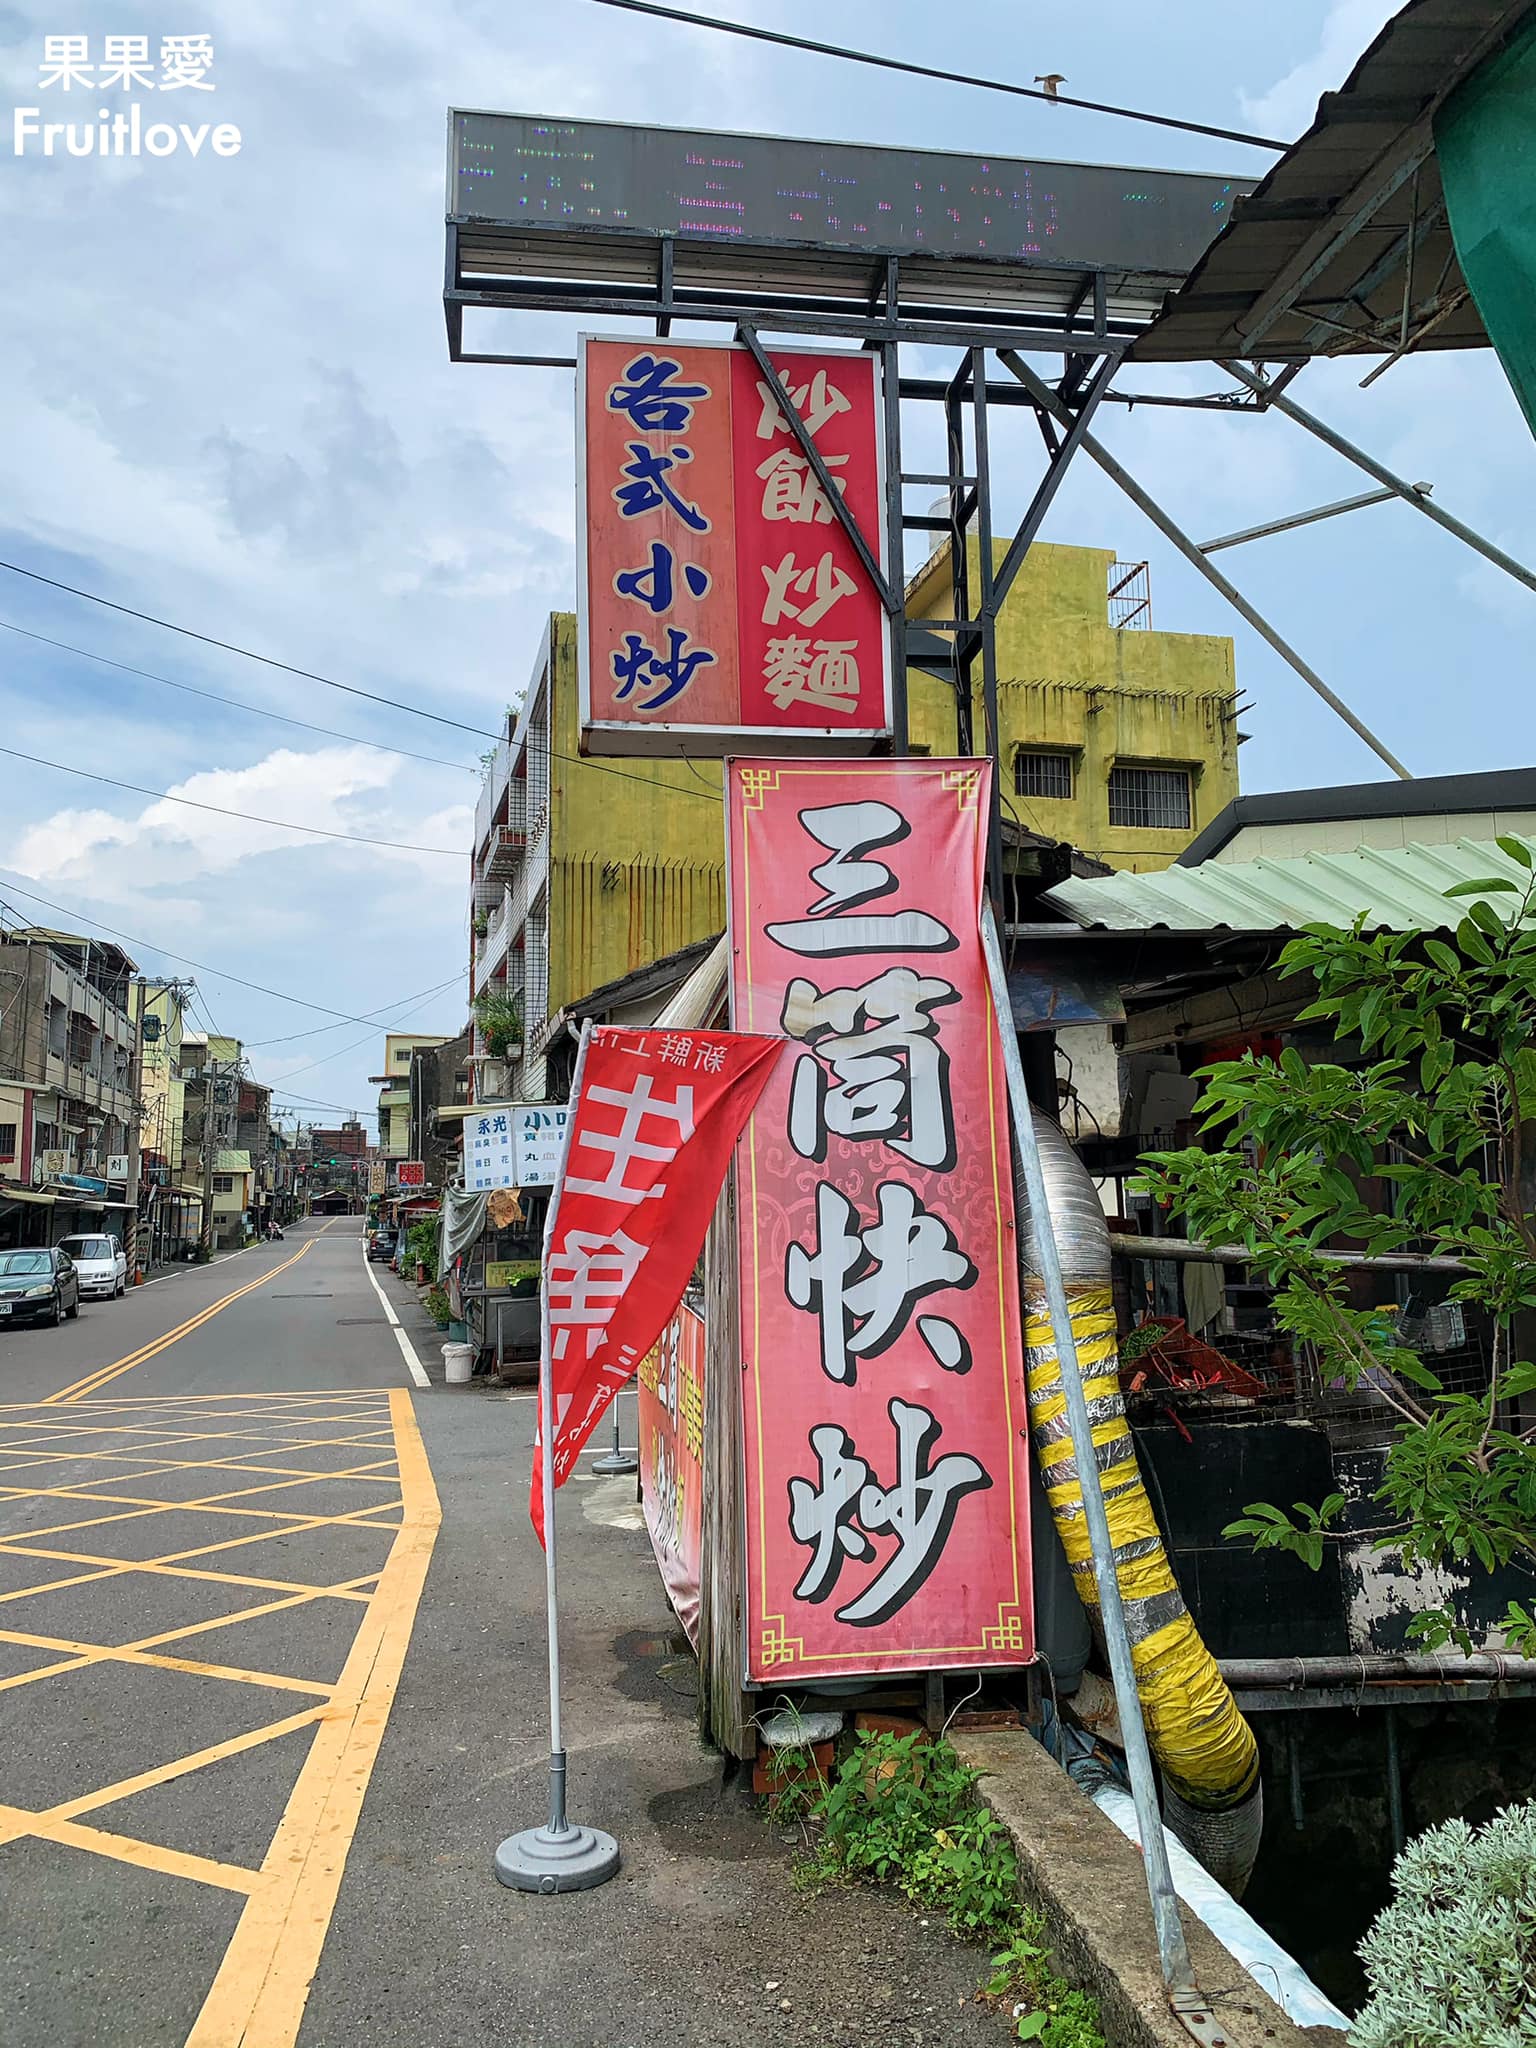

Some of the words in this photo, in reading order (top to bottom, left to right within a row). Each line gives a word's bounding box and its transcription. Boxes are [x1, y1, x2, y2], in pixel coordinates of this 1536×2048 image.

[605, 351, 718, 714] 各式小炒
[763, 799, 993, 1627] 三筒快炒
